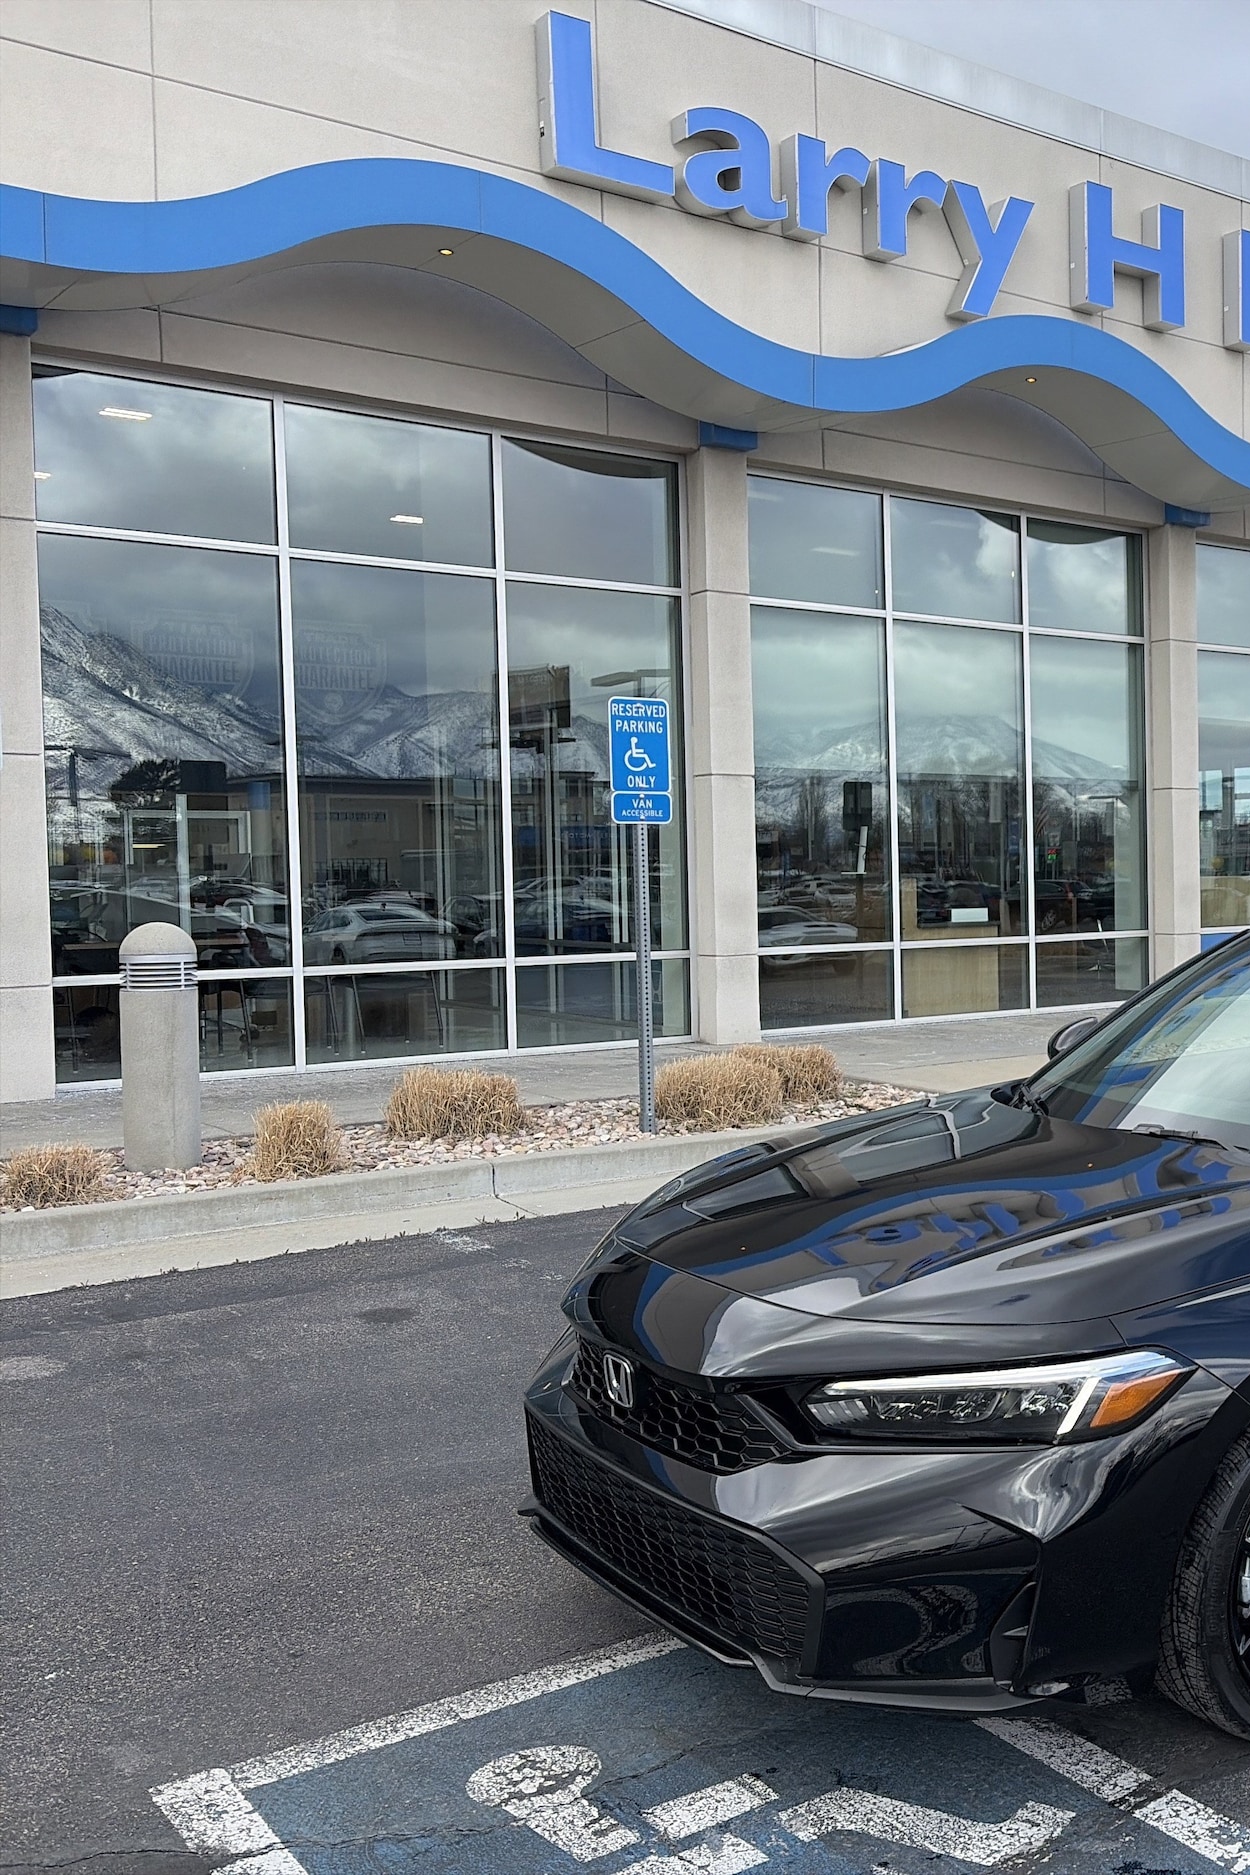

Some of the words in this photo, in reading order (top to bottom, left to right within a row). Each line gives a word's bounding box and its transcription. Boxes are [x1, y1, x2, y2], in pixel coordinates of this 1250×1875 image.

[538, 9, 1035, 321] Larry
[1074, 180, 1185, 330] H
[611, 703, 666, 718] RESERVED
[615, 719, 663, 734] PARKING
[627, 775, 656, 788] ONLY
[632, 798, 653, 809] VAN
[621, 809, 664, 817] ACCESSIBLE
